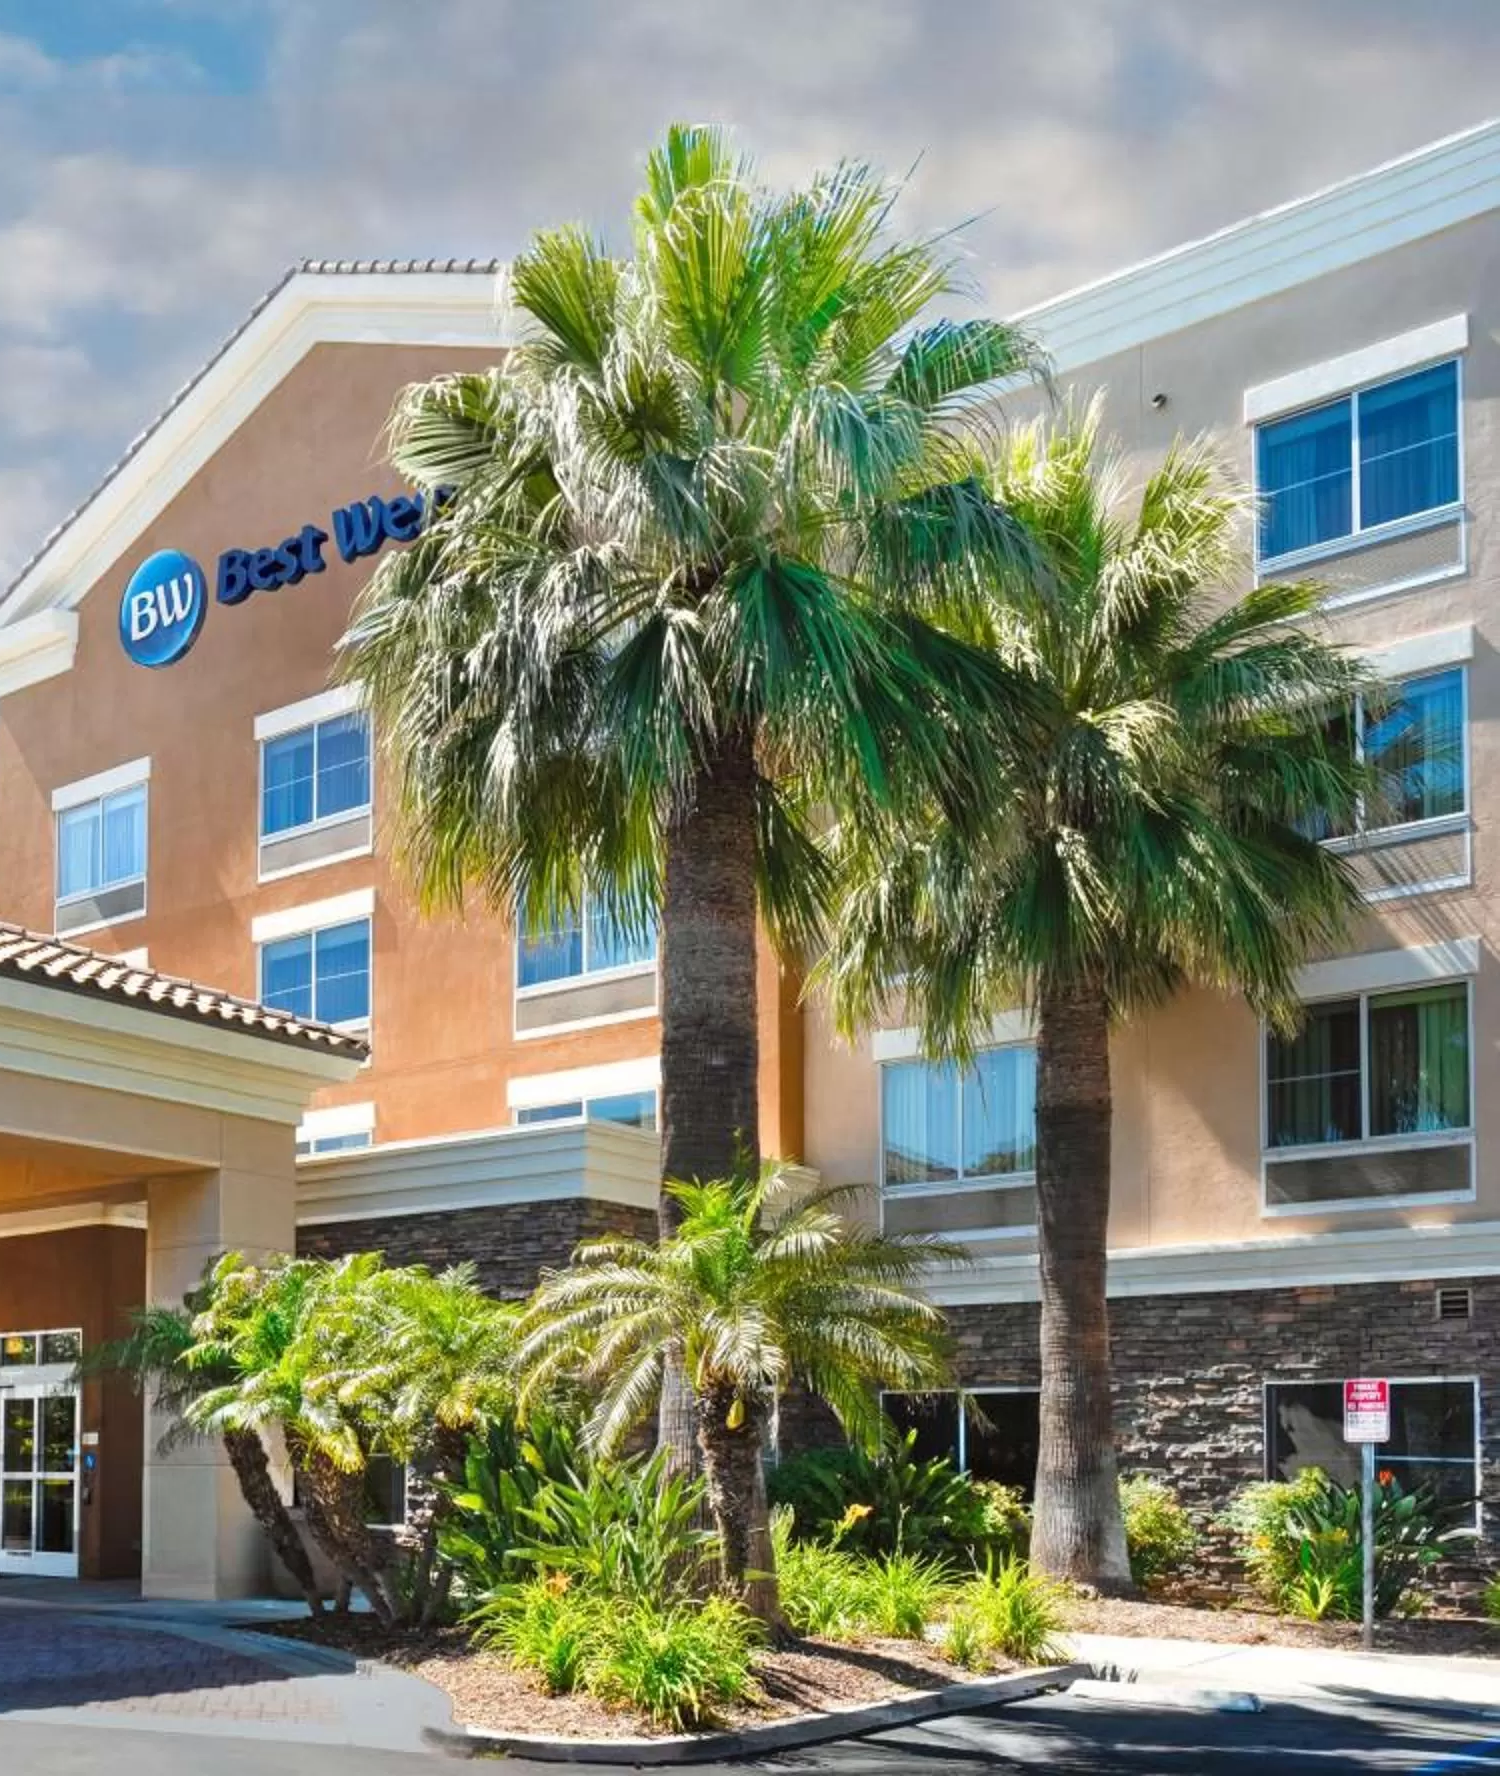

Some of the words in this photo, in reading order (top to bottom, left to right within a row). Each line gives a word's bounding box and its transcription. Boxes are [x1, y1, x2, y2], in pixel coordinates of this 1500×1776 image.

[216, 524, 329, 606] Best
[332, 484, 459, 563] We
[131, 572, 193, 641] BW
